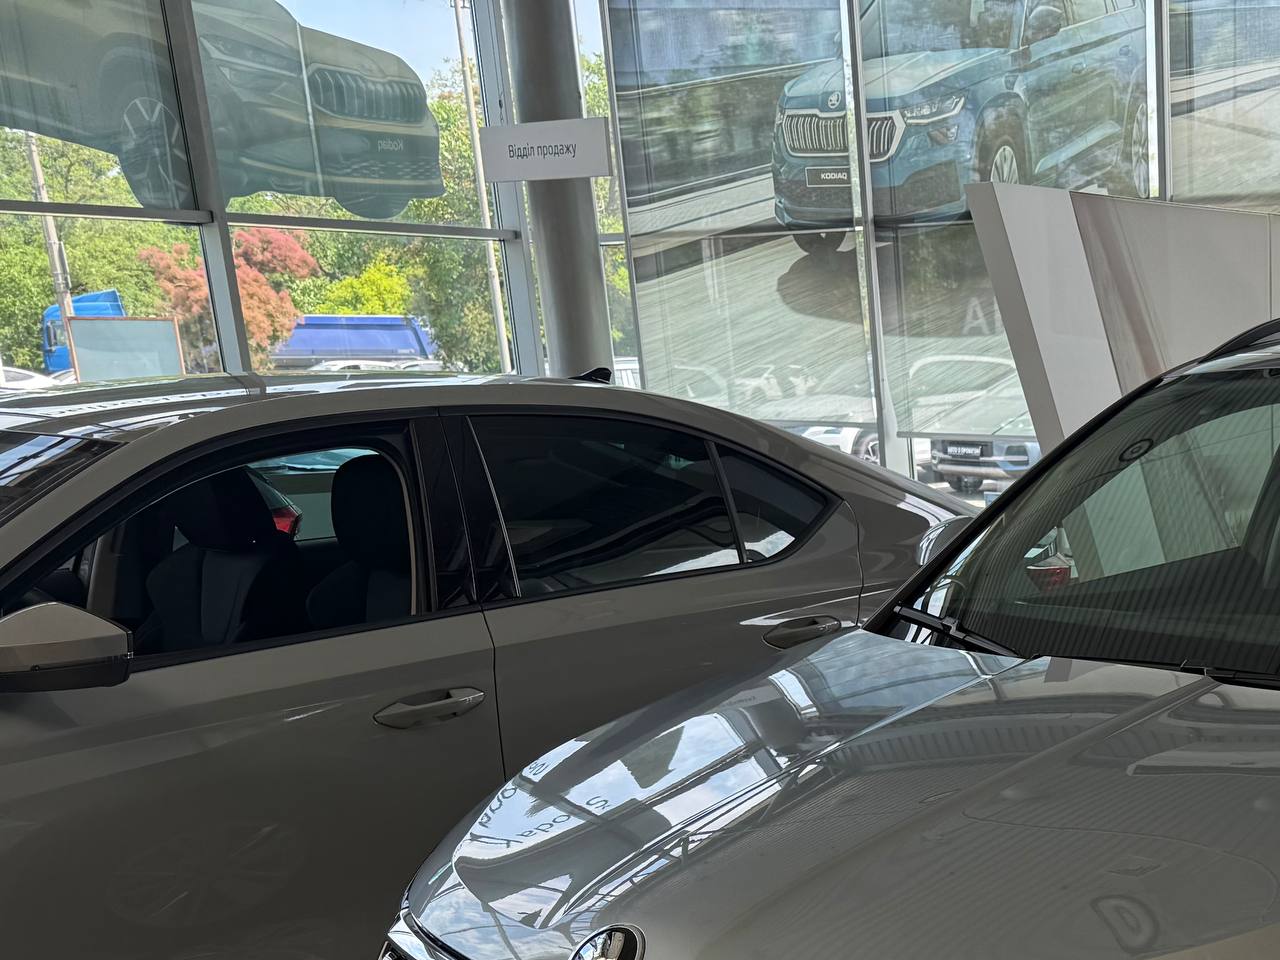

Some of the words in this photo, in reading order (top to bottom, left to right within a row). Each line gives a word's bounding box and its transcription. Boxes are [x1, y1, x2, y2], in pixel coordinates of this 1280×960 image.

[508, 143, 535, 159] Відділ
[537, 143, 577, 159] продажу
[821, 172, 848, 180] KODIAQ
